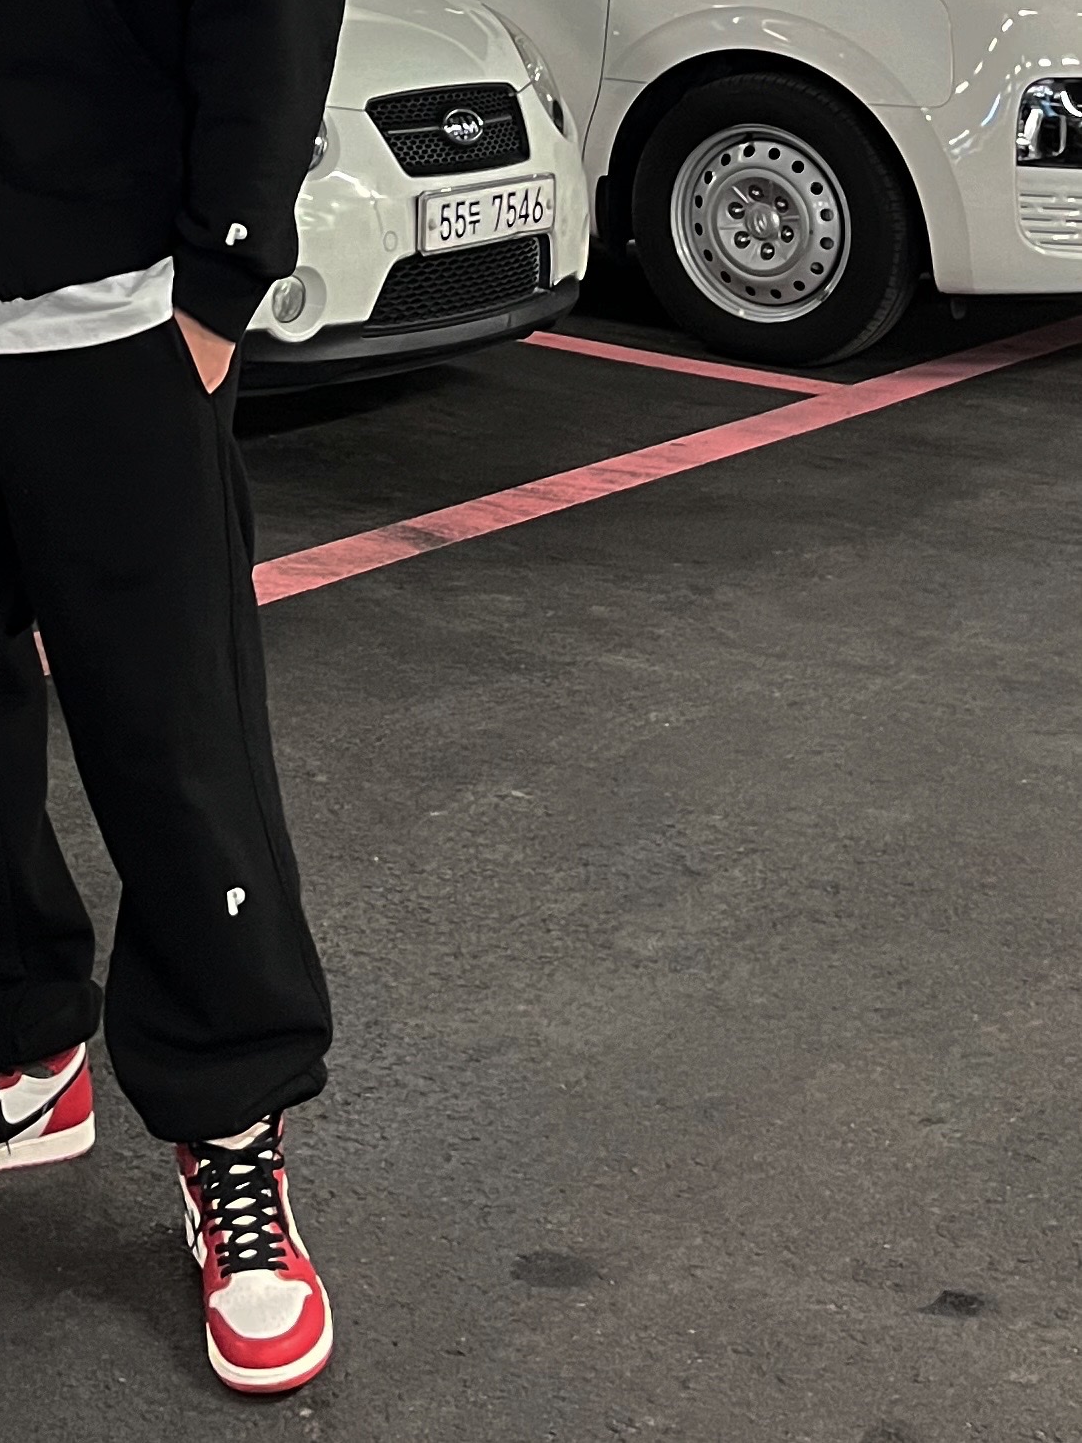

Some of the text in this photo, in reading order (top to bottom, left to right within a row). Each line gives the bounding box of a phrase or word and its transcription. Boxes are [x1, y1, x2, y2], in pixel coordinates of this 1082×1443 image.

[440, 186, 544, 241] 55두 7546
[225, 223, 248, 246] P
[227, 887, 246, 916] P
